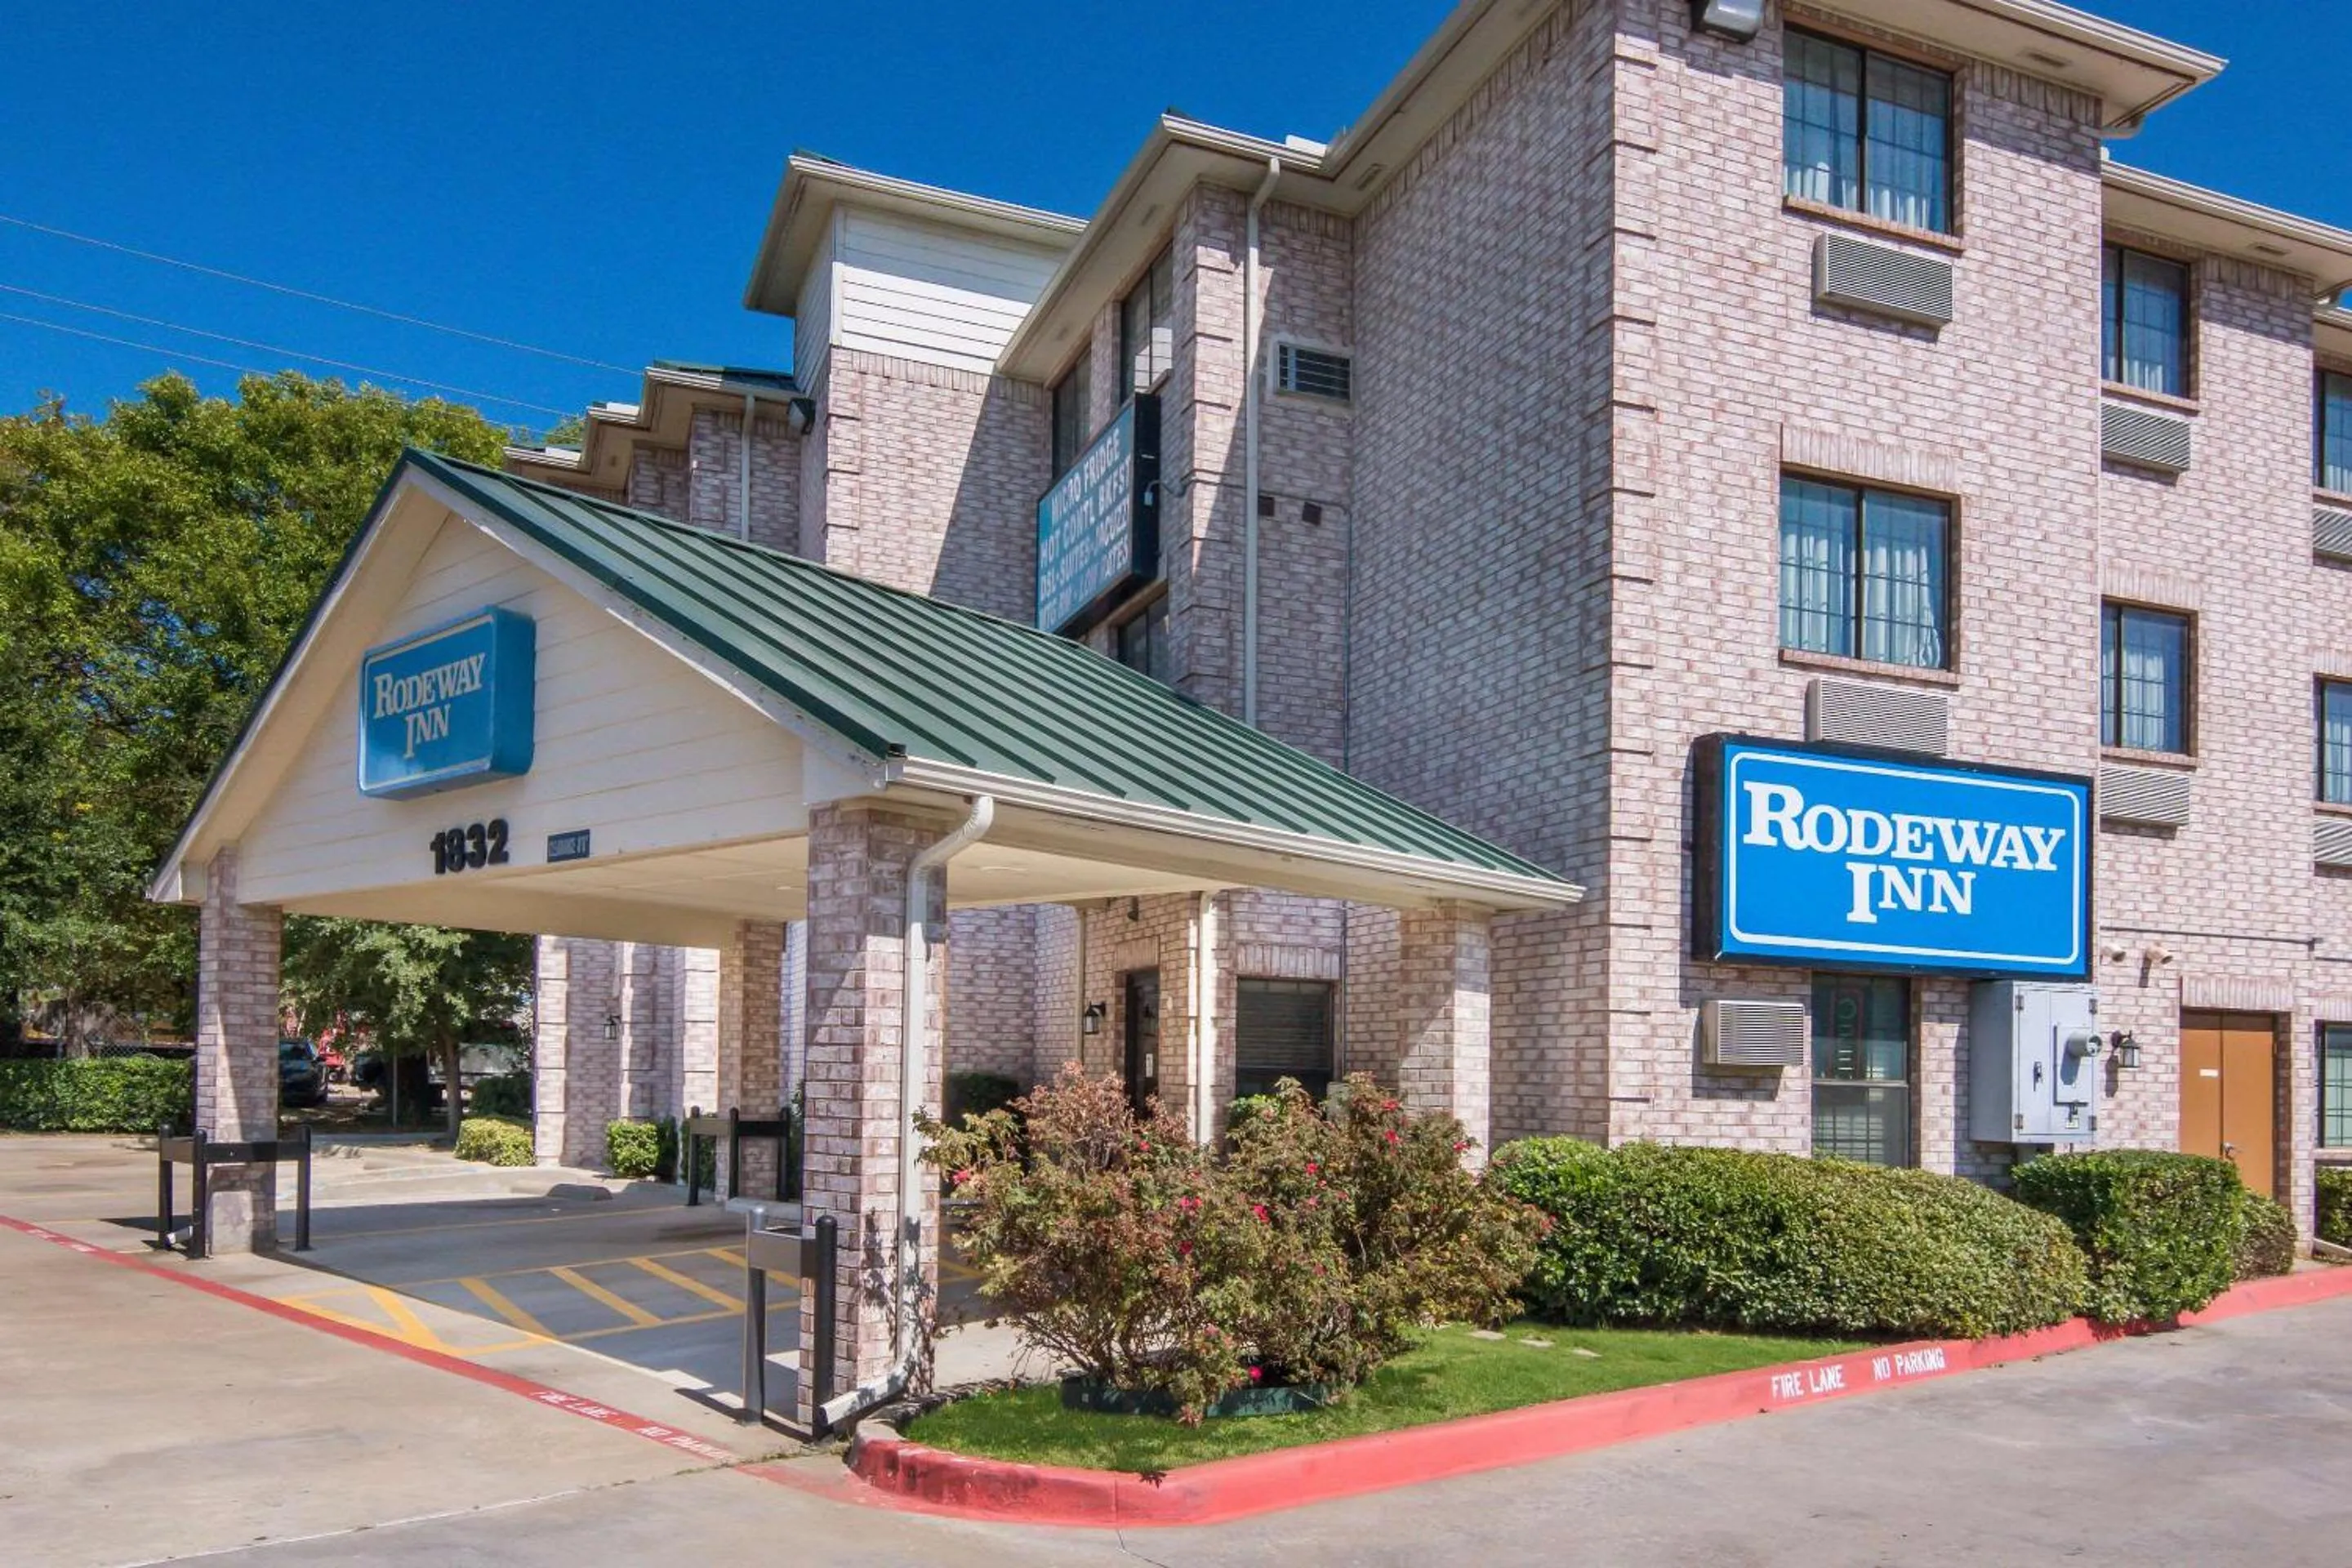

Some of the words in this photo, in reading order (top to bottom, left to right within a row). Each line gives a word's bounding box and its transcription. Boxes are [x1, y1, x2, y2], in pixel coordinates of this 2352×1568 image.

[1052, 472, 1081, 528] MICRO
[1084, 428, 1120, 493] FRIDGE
[1040, 528, 1062, 569] HOT
[1098, 453, 1130, 516] BKFST
[373, 652, 486, 719] RODEWAY
[403, 704, 451, 760] INN
[430, 818, 510, 875] 1832
[1743, 780, 2065, 871] RODEWAY
[1846, 862, 1976, 924] INN
[1771, 1371, 1804, 1400] FIRE
[1808, 1364, 1846, 1393] LANE
[1872, 1356, 1891, 1381] NO
[1895, 1348, 1946, 1376] PARKING
